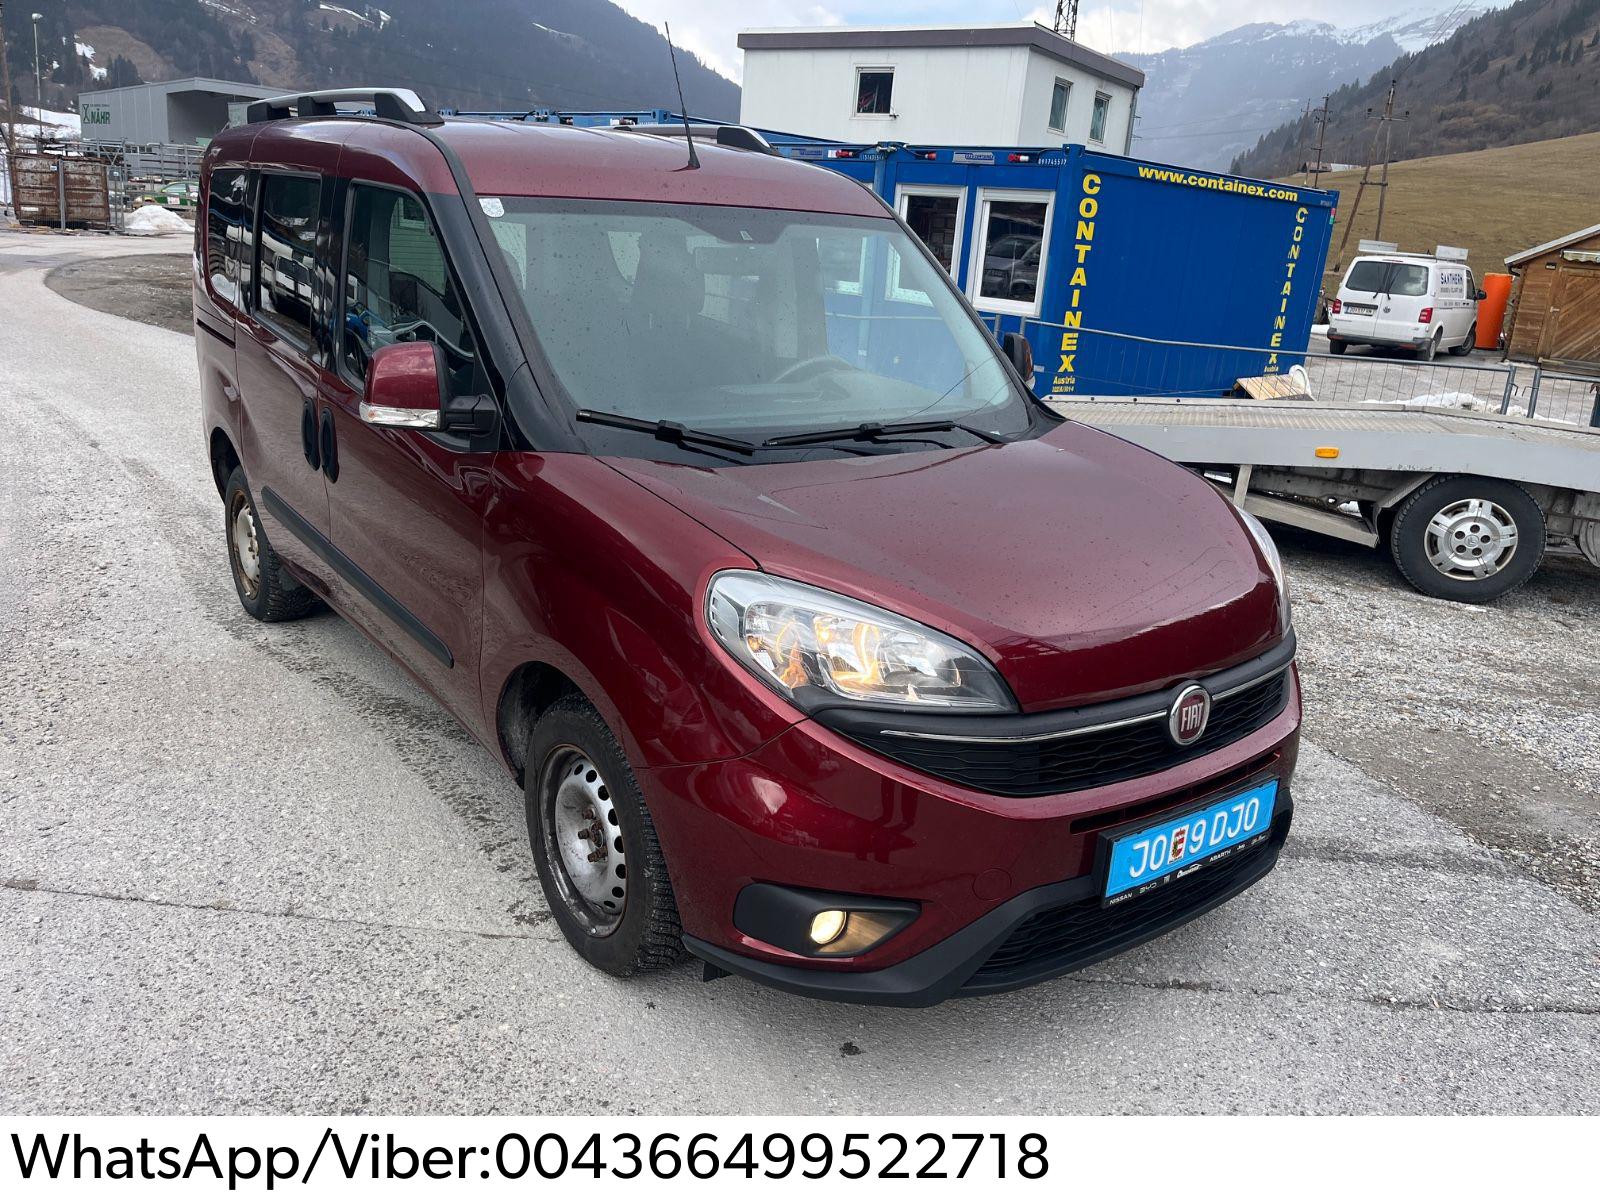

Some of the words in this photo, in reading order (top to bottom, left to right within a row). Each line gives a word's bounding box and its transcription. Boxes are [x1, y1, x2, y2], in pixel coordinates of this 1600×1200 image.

[1138, 166, 1299, 202] www.containex.com
[1057, 173, 1102, 373] CONTAINEX
[1268, 206, 1309, 365] CONTAINEX
[1053, 376, 1075, 385] Austria
[1181, 702, 1204, 732] FIAT
[1129, 834, 1168, 879] JO
[1189, 819, 1207, 854] 9
[1109, 892, 1134, 905] NISSAN
